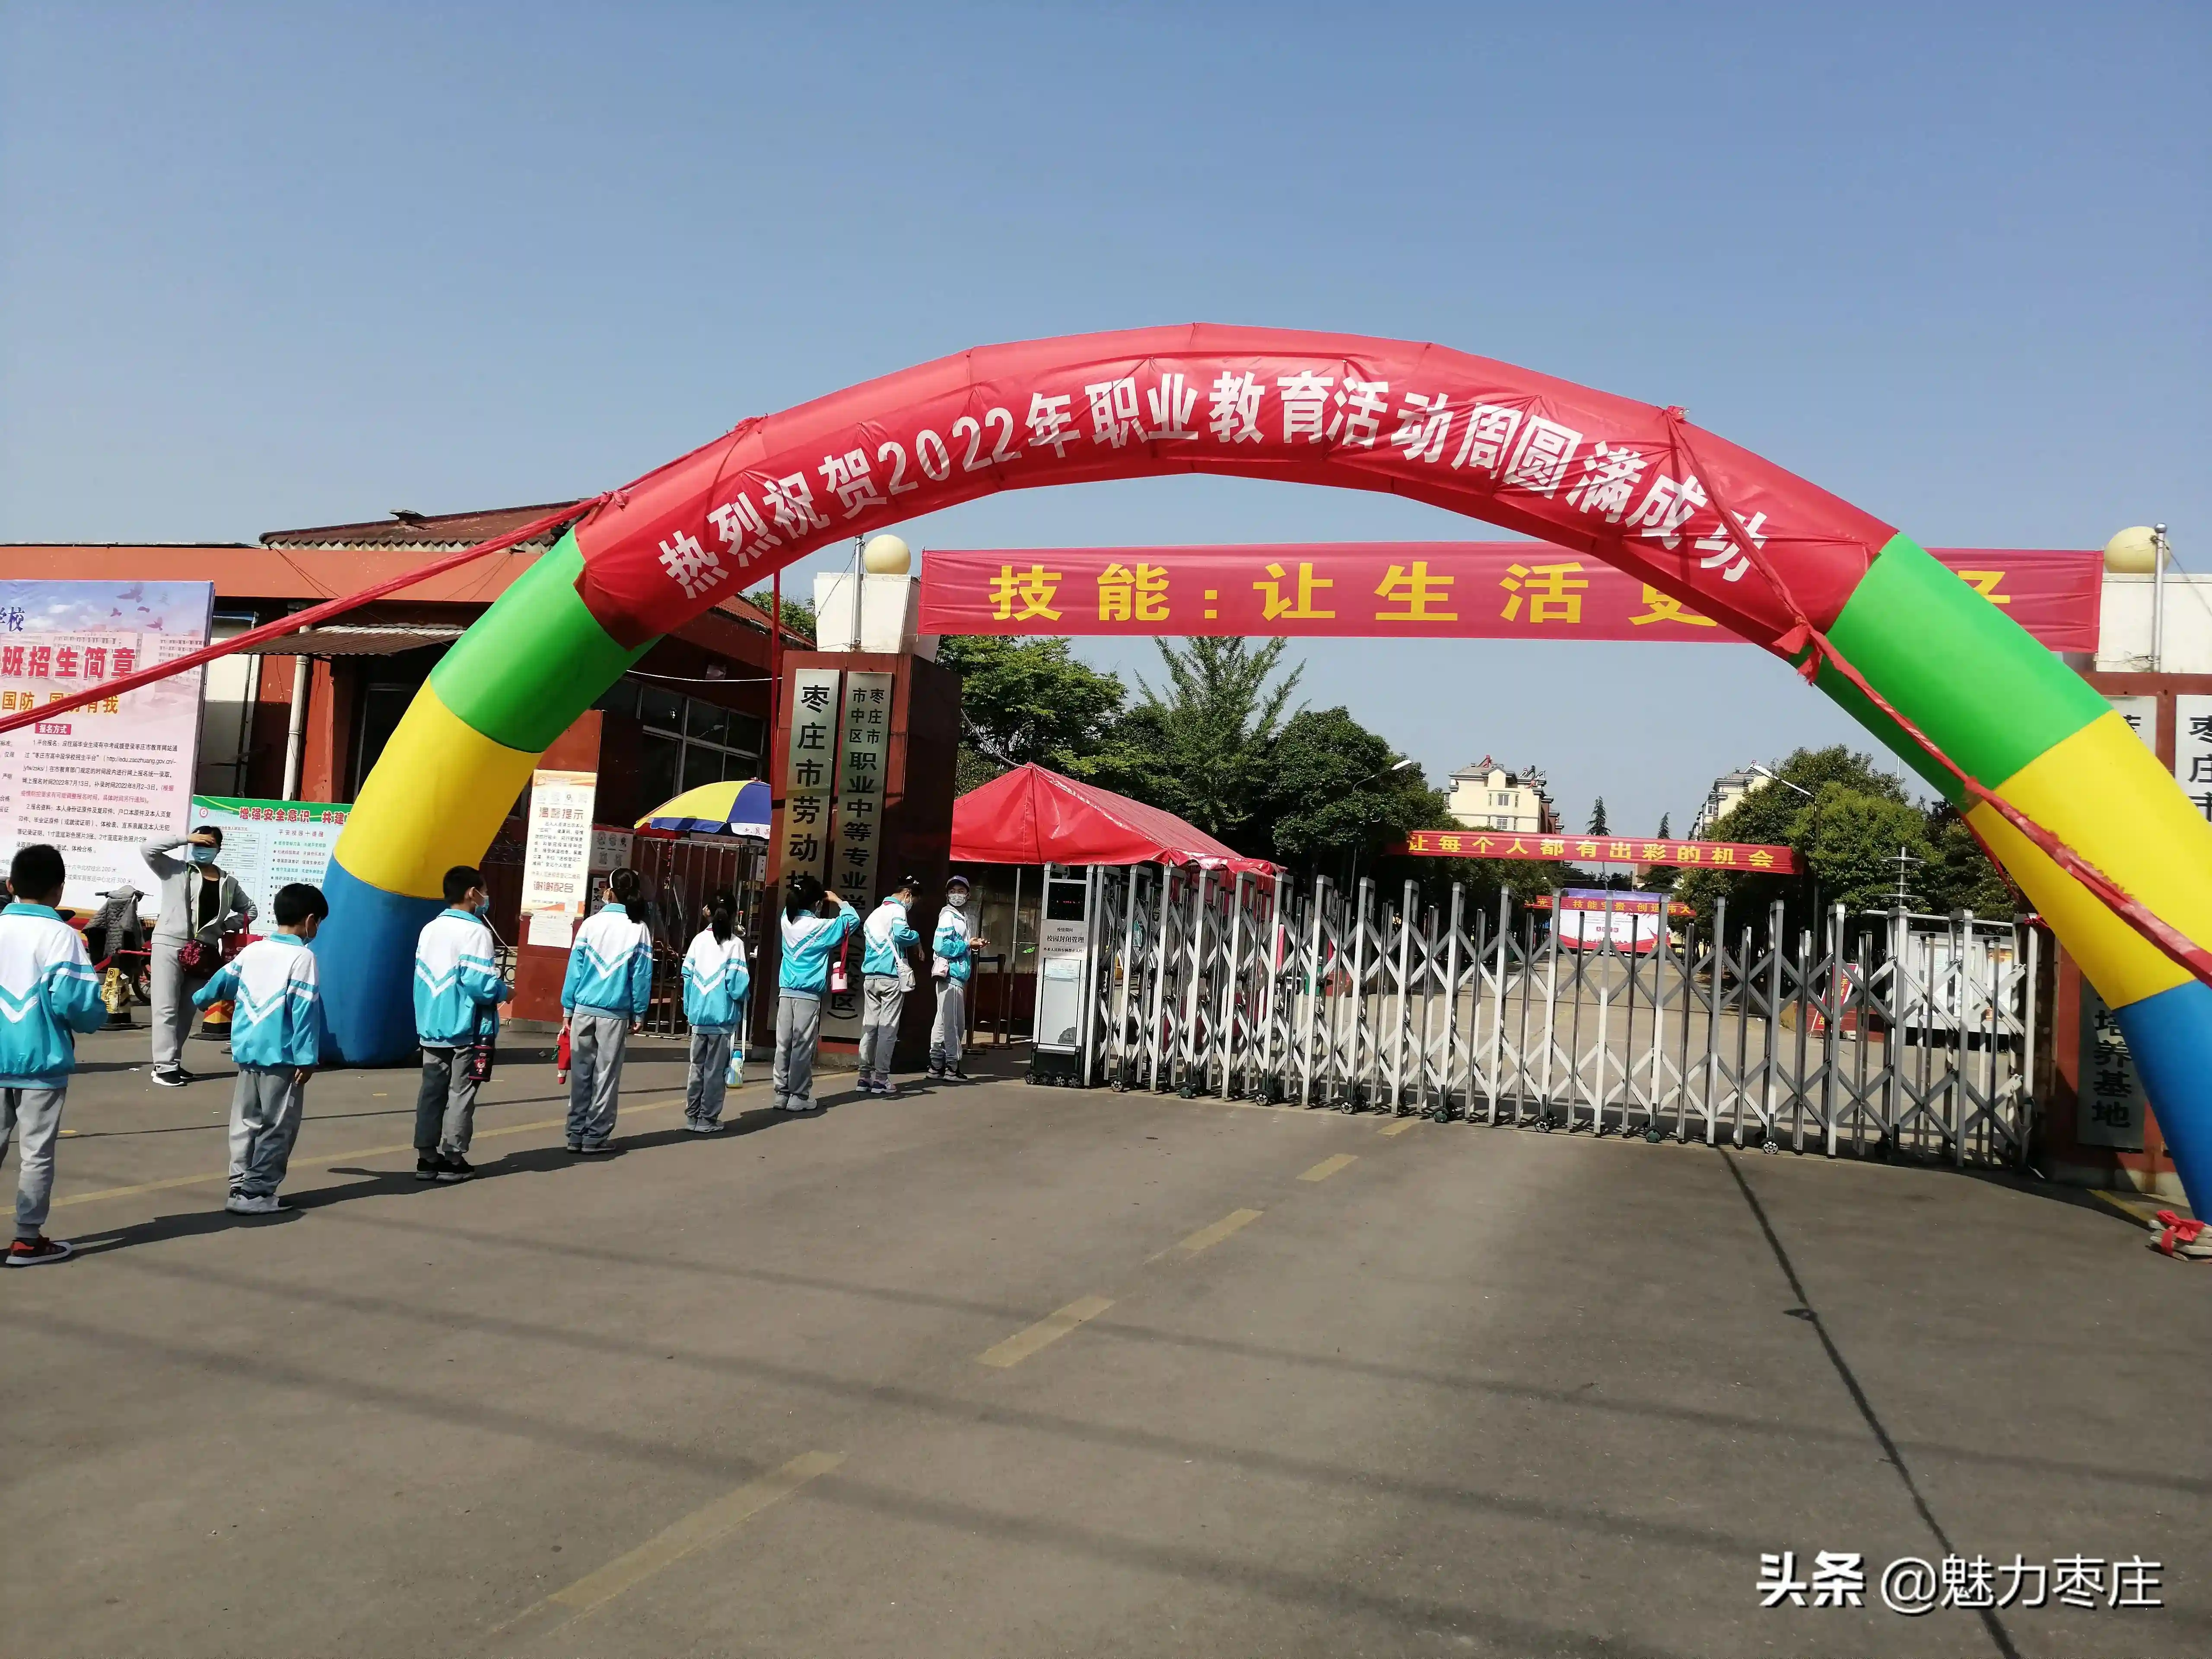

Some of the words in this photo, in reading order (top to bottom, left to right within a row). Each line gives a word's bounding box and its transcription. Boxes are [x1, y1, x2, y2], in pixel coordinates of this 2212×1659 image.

[657, 369, 1770, 601] 热烈祝贺2022年职业教育活动周圆满成功
[988, 562, 2010, 626] 技能：让生活更
[849, 687, 867, 744] 市中区
[867, 688, 885, 744] 枣庄市
[39, 724, 67, 734] 报名方式
[238, 807, 310, 823] 增强安全意识
[321, 810, 351, 825] 共建
[539, 807, 584, 820] 温馨提示
[1408, 834, 1774, 868] 让每个人都有出彩的机会
[534, 881, 574, 893] 谢谢配合
[1047, 935, 1084, 944] 校园封闭管理
